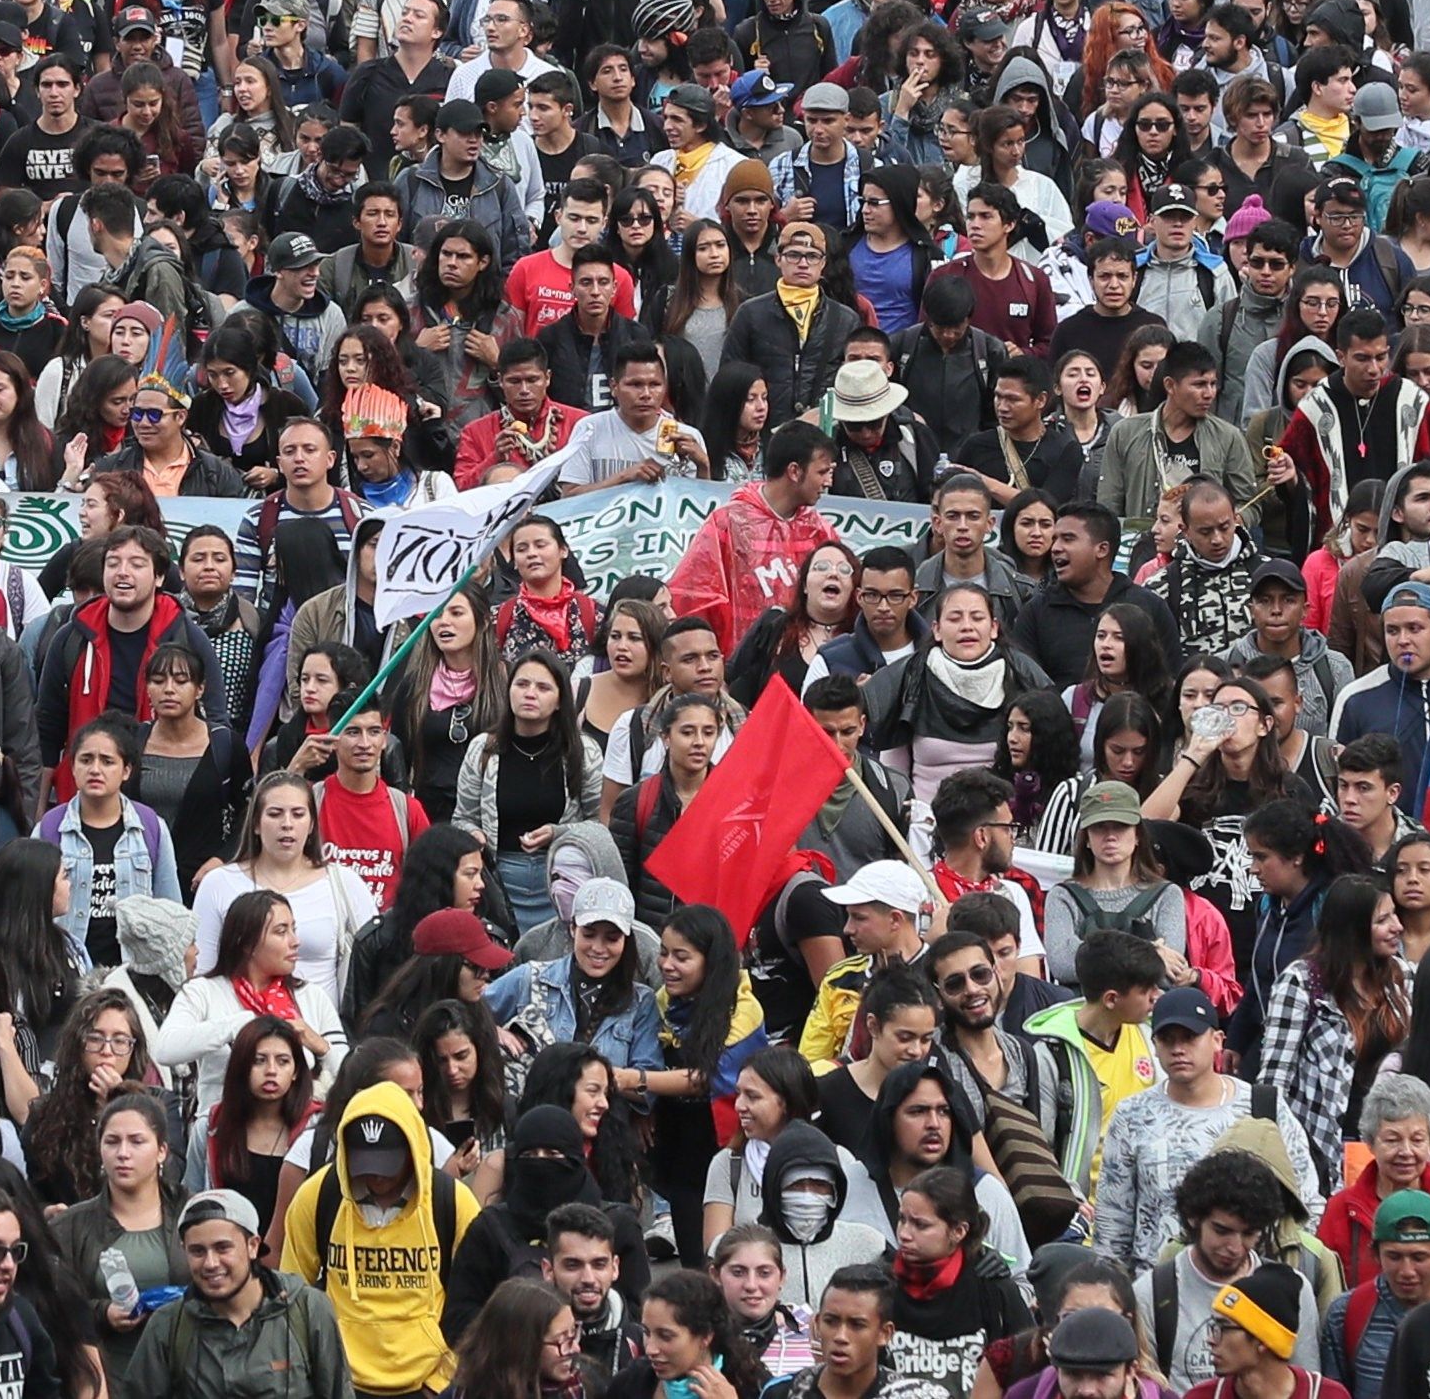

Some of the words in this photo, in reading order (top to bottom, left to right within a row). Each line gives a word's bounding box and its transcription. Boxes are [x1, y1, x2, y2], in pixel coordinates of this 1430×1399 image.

[321, 842, 381, 862] Obreros
[338, 1273, 391, 1289] WARING
[894, 1351, 962, 1380] Bridge
